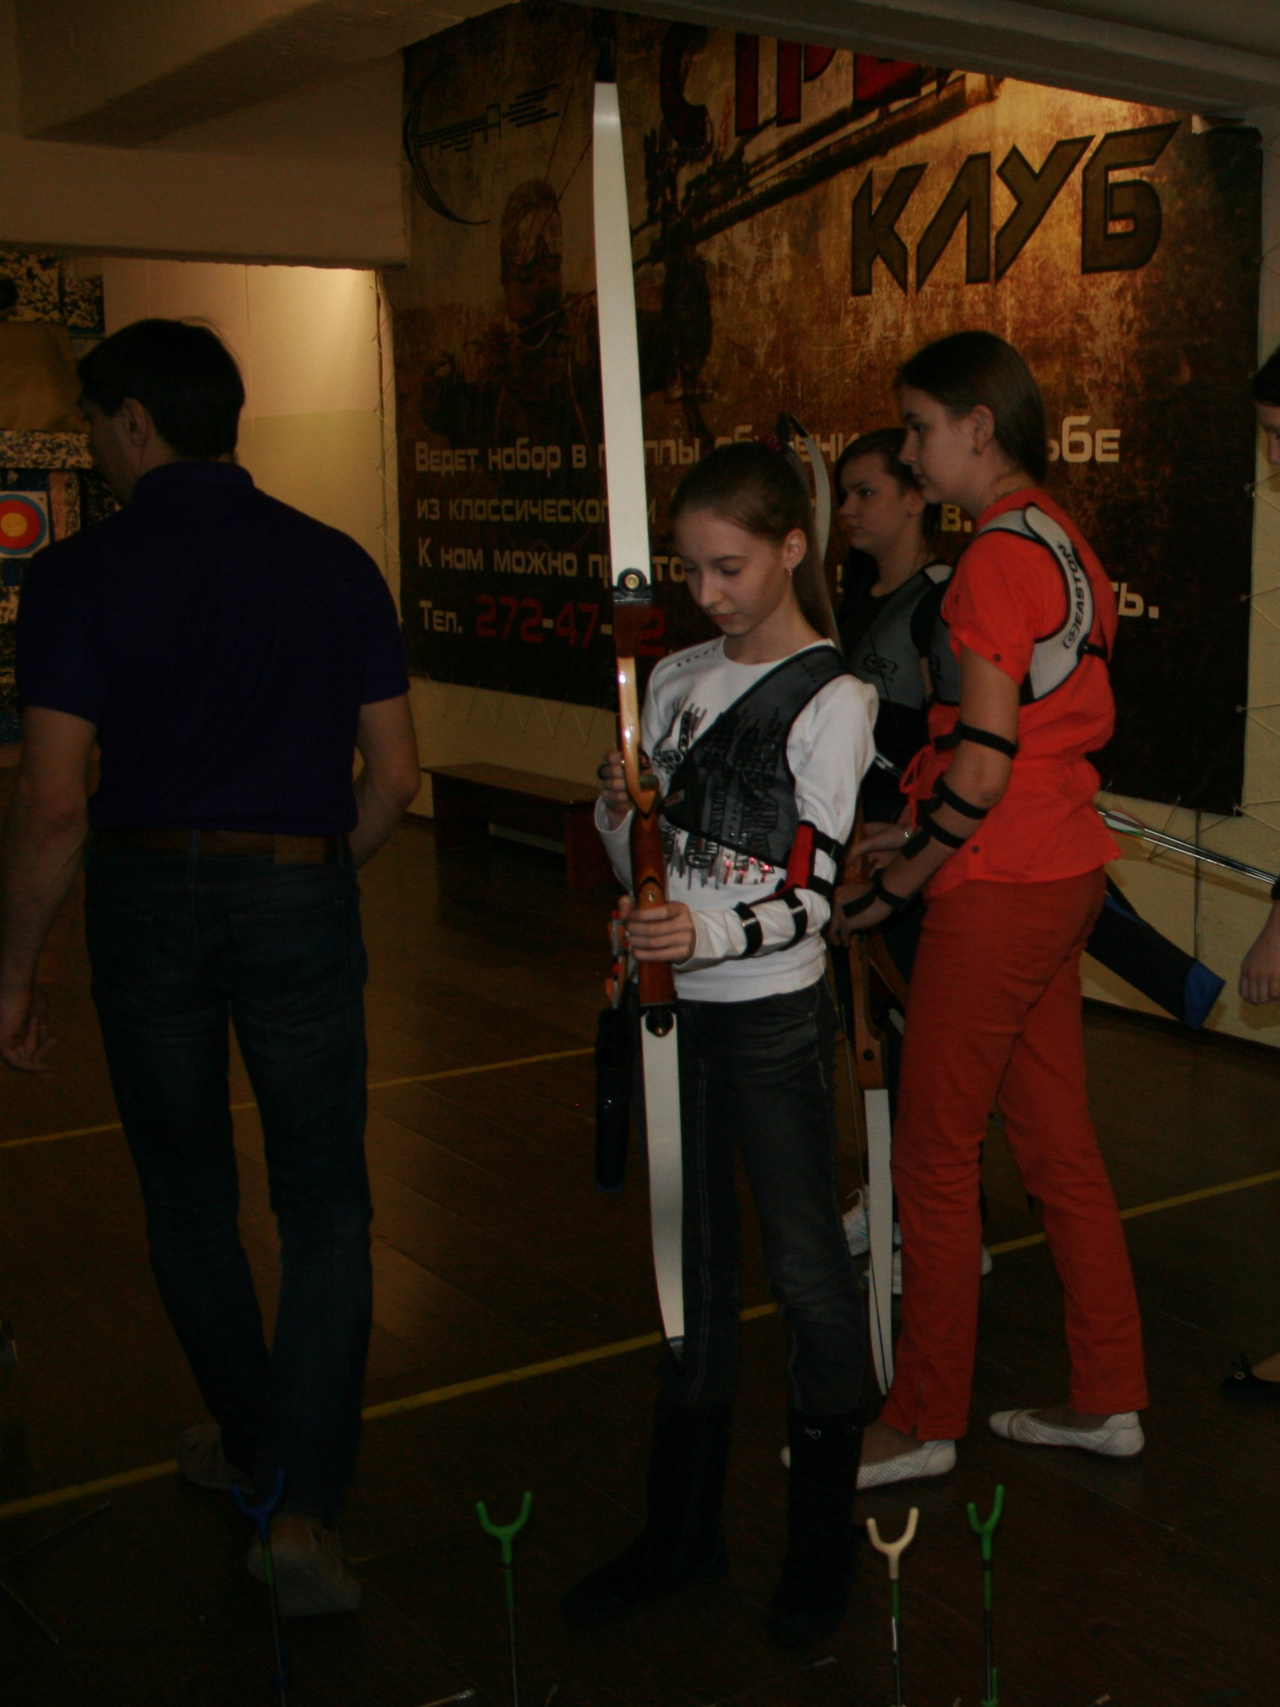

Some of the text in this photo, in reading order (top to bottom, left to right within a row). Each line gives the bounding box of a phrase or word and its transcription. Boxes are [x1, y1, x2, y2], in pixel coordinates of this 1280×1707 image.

[852, 120, 1181, 297] КЛУБ
[415, 441, 479, 478] Ведет
[488, 437, 562, 480] набор
[571, 444, 588, 469] в
[416, 498, 441, 522] из
[417, 537, 433, 568] К
[440, 547, 485, 572] нам
[493, 549, 579, 578] можно
[1057, 543, 1085, 627] EASTON
